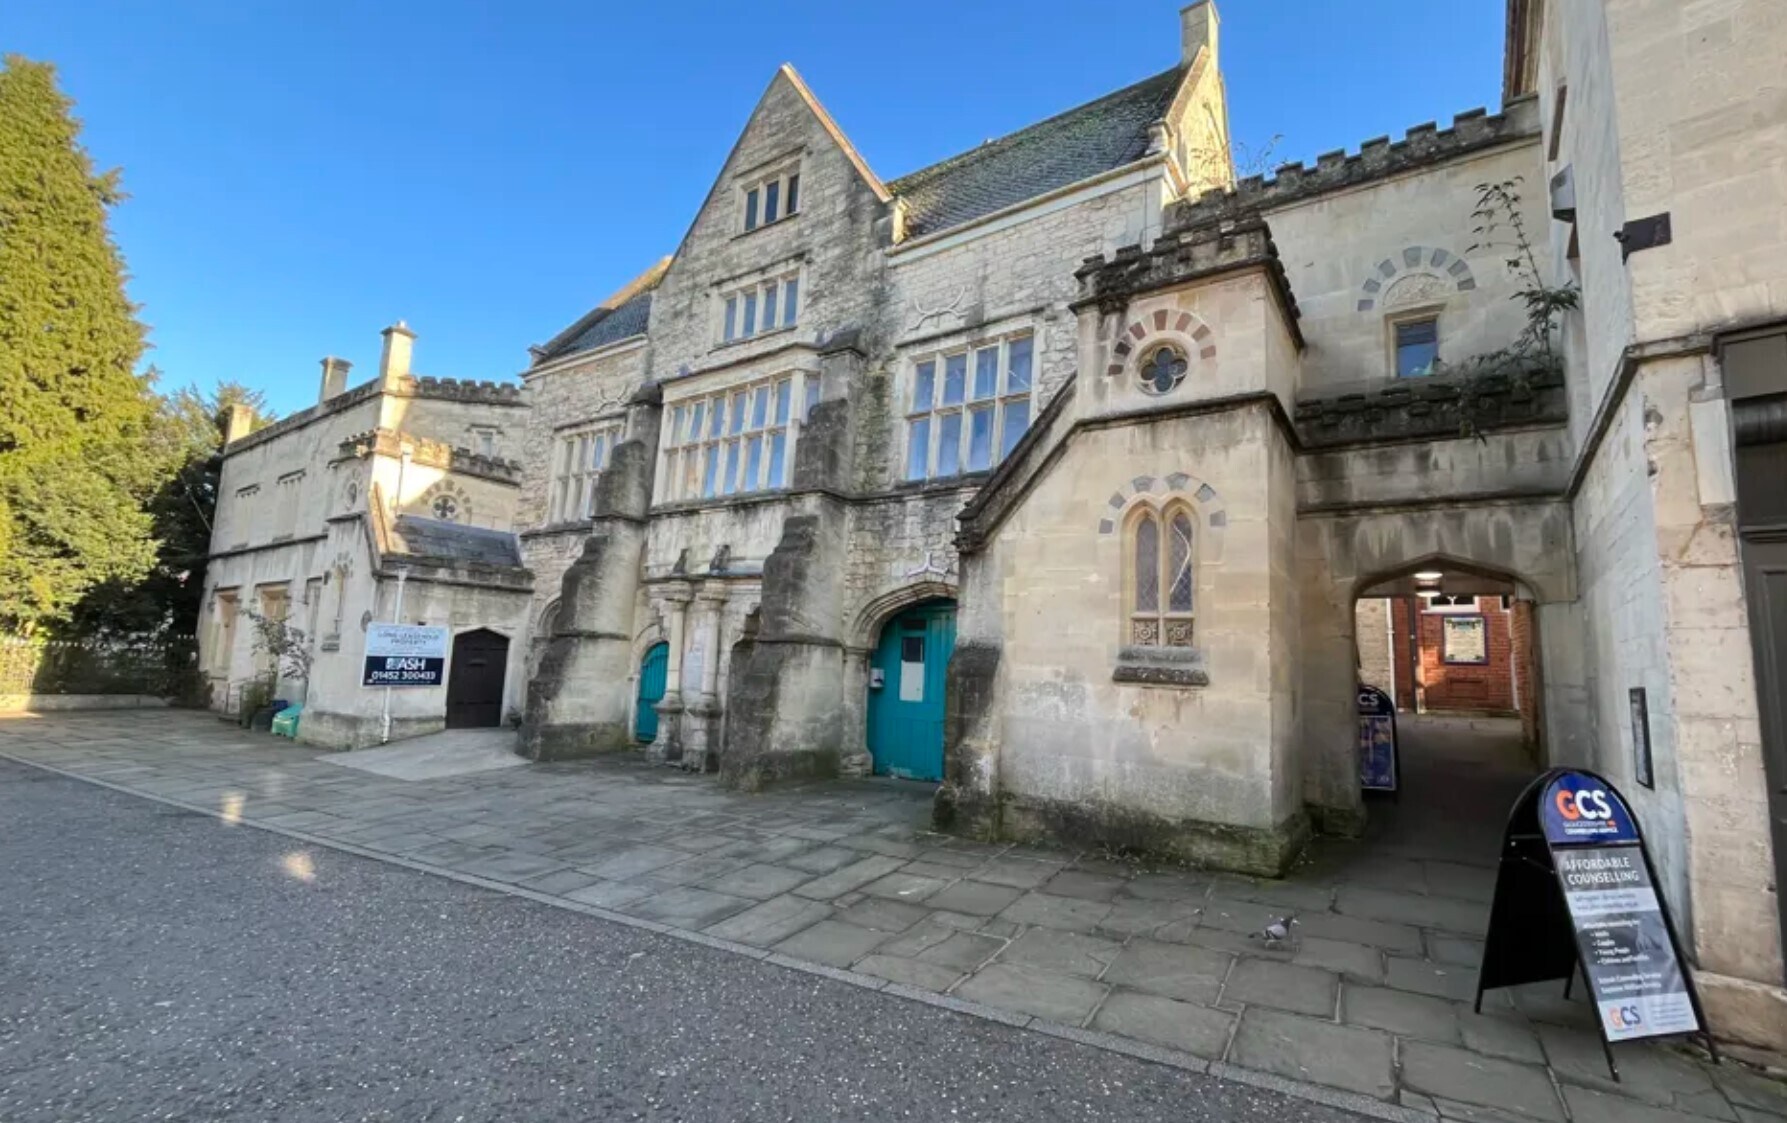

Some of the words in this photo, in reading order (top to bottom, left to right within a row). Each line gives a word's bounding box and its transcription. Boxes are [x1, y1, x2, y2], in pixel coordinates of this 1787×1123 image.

[371, 671, 399, 680] 01452
[1556, 789, 1612, 820] GCS
[1565, 857, 1630, 871] AFFORDABLE
[1567, 870, 1639, 885] COUNSELLING
[1610, 1005, 1641, 1027] GCS
